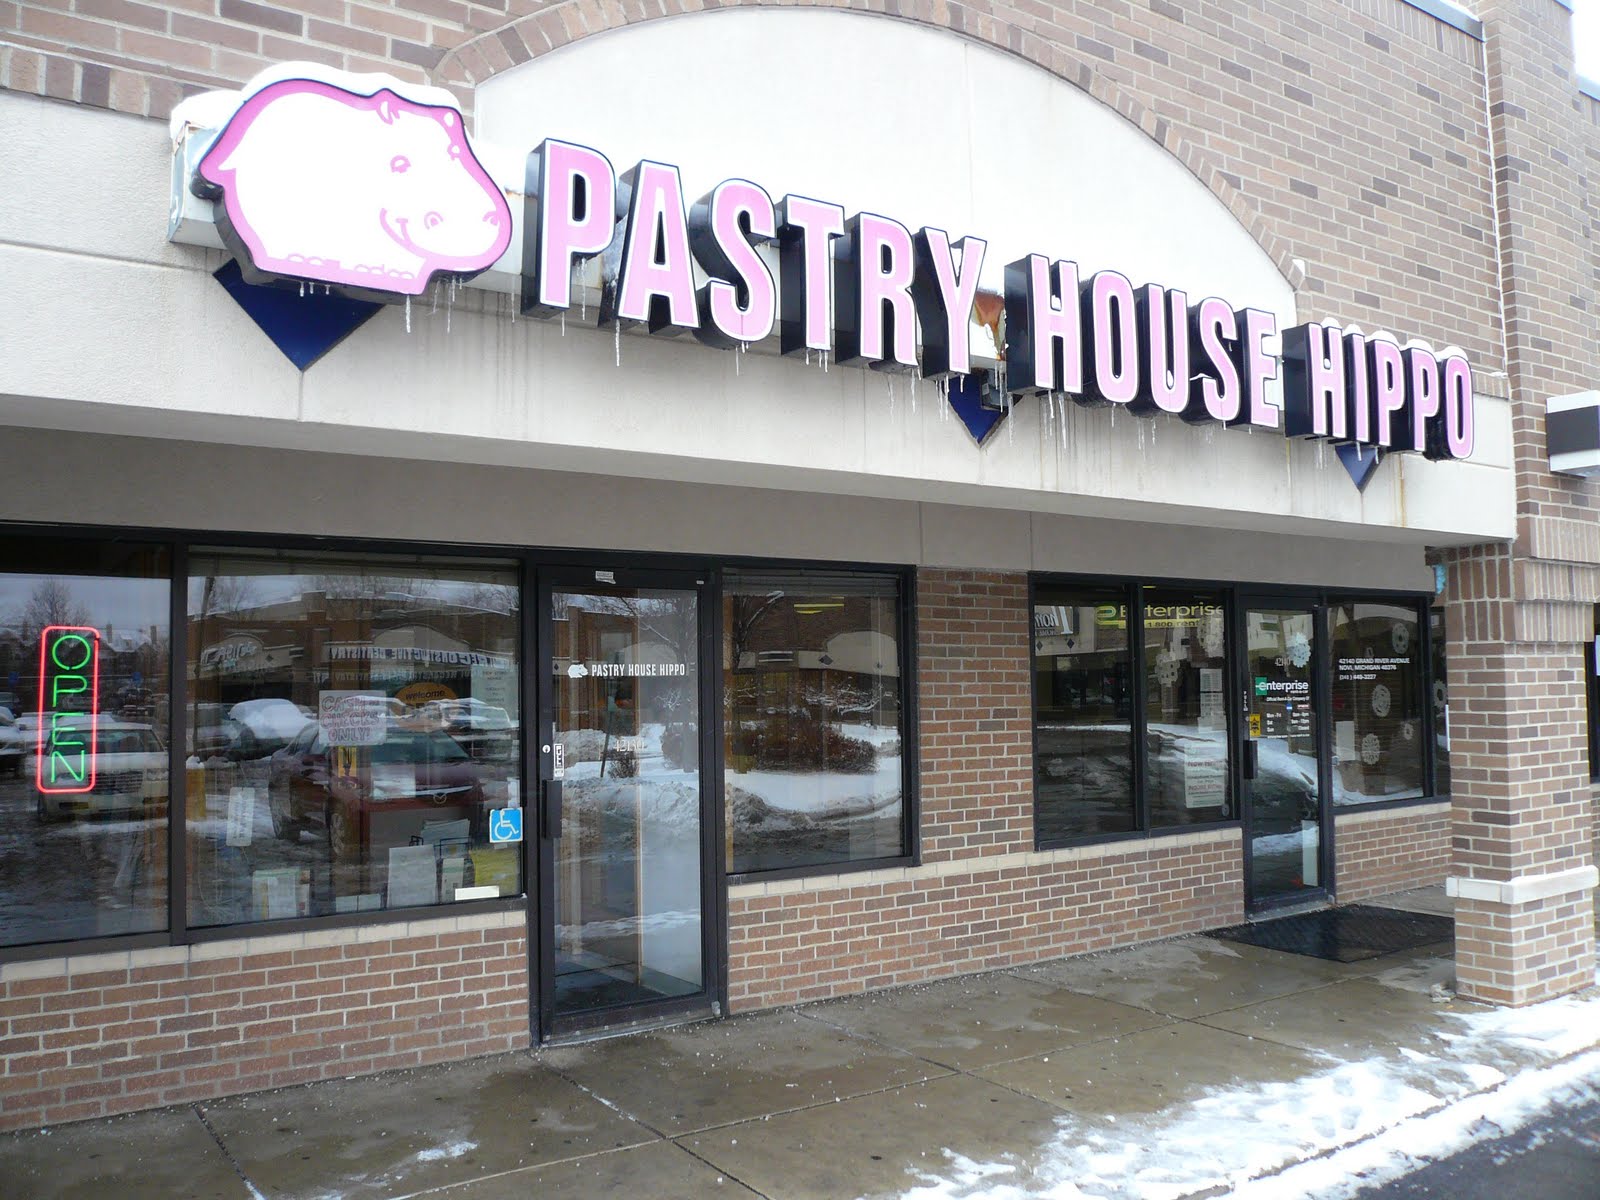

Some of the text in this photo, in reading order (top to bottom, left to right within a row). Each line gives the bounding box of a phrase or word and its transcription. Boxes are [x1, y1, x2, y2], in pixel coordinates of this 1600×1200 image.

[524, 138, 1474, 460] PASTRY HOUSE HIPPO
[591, 663, 685, 677] PASTRY HOUSE HIPPO
[1255, 680, 1309, 693] enterprise
[406, 690, 446, 699] welcome
[51, 635, 91, 783] OPEN
